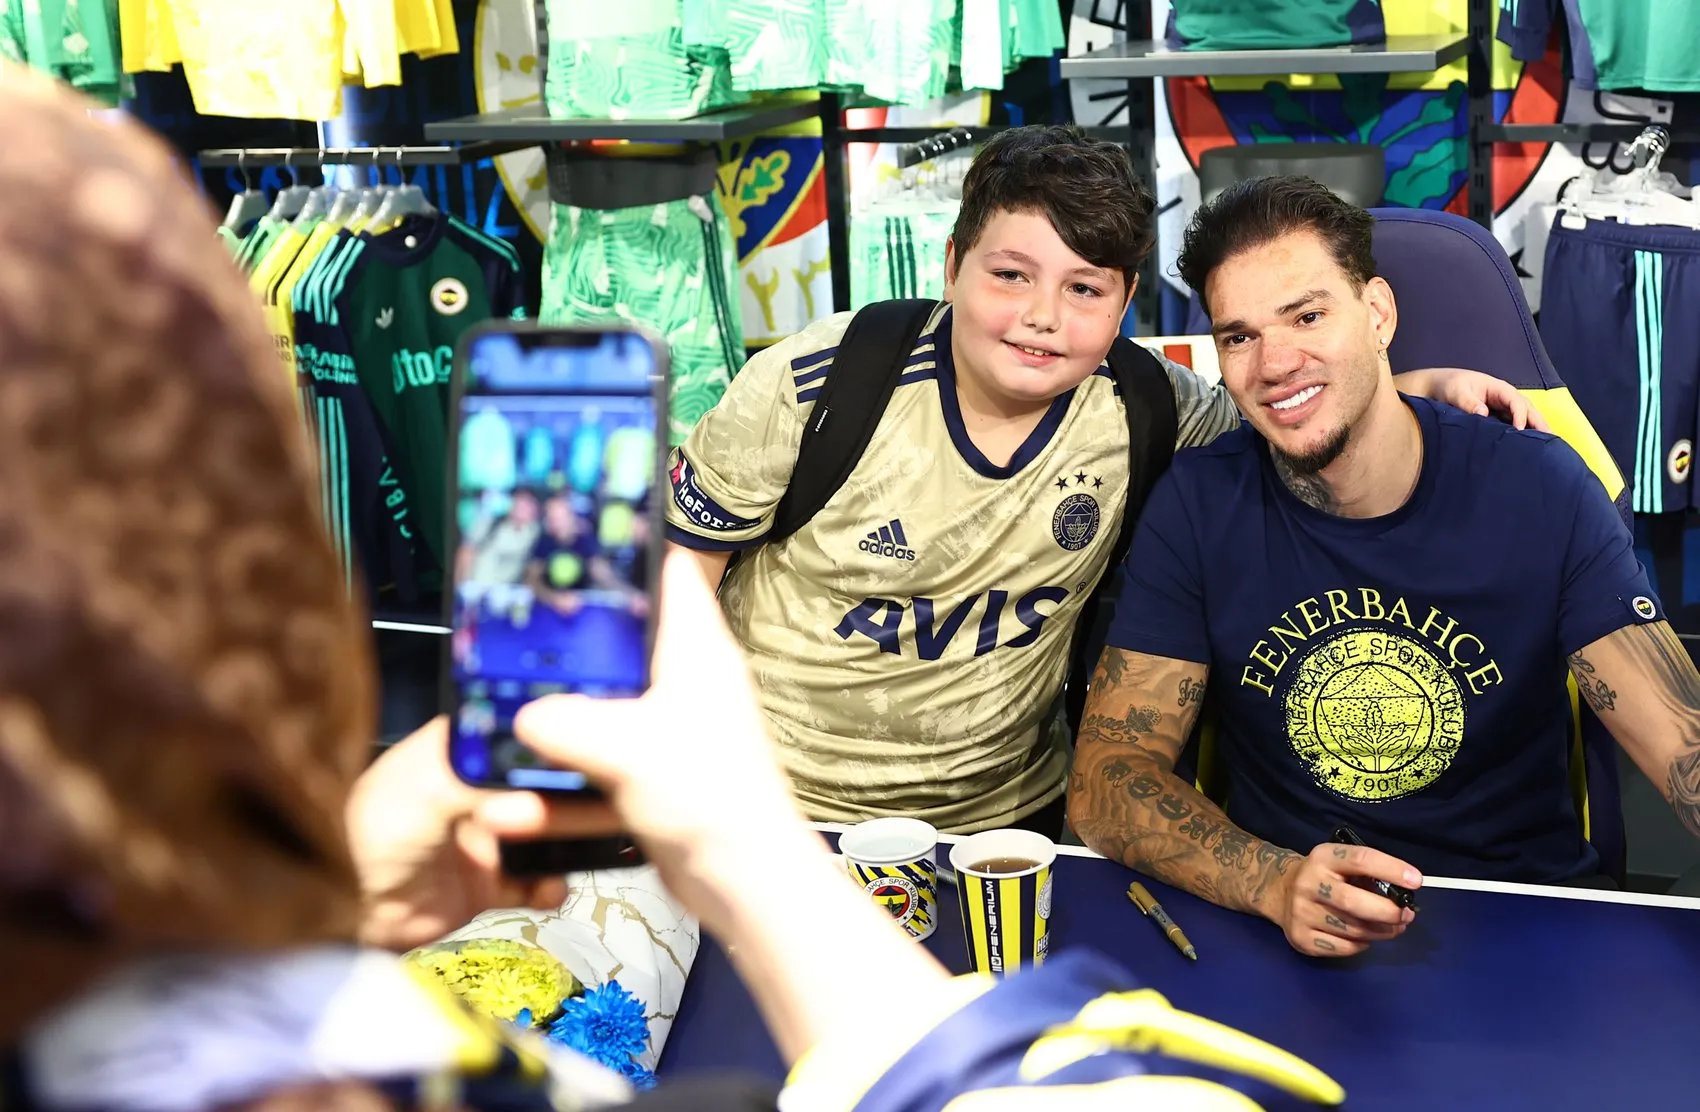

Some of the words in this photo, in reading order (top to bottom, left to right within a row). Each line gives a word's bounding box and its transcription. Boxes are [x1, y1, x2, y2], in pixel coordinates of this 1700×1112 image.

[1079, 495, 1096, 508] SPOR
[858, 538, 916, 561] adidas
[833, 586, 1070, 661] AVIS
[1240, 587, 1504, 698] FENERBAHÇE
[1369, 637, 1430, 675] SPOR
[1352, 775, 1401, 792] 1907
[888, 878, 909, 889] SPOR
[986, 880, 1001, 956] FENERIUM
